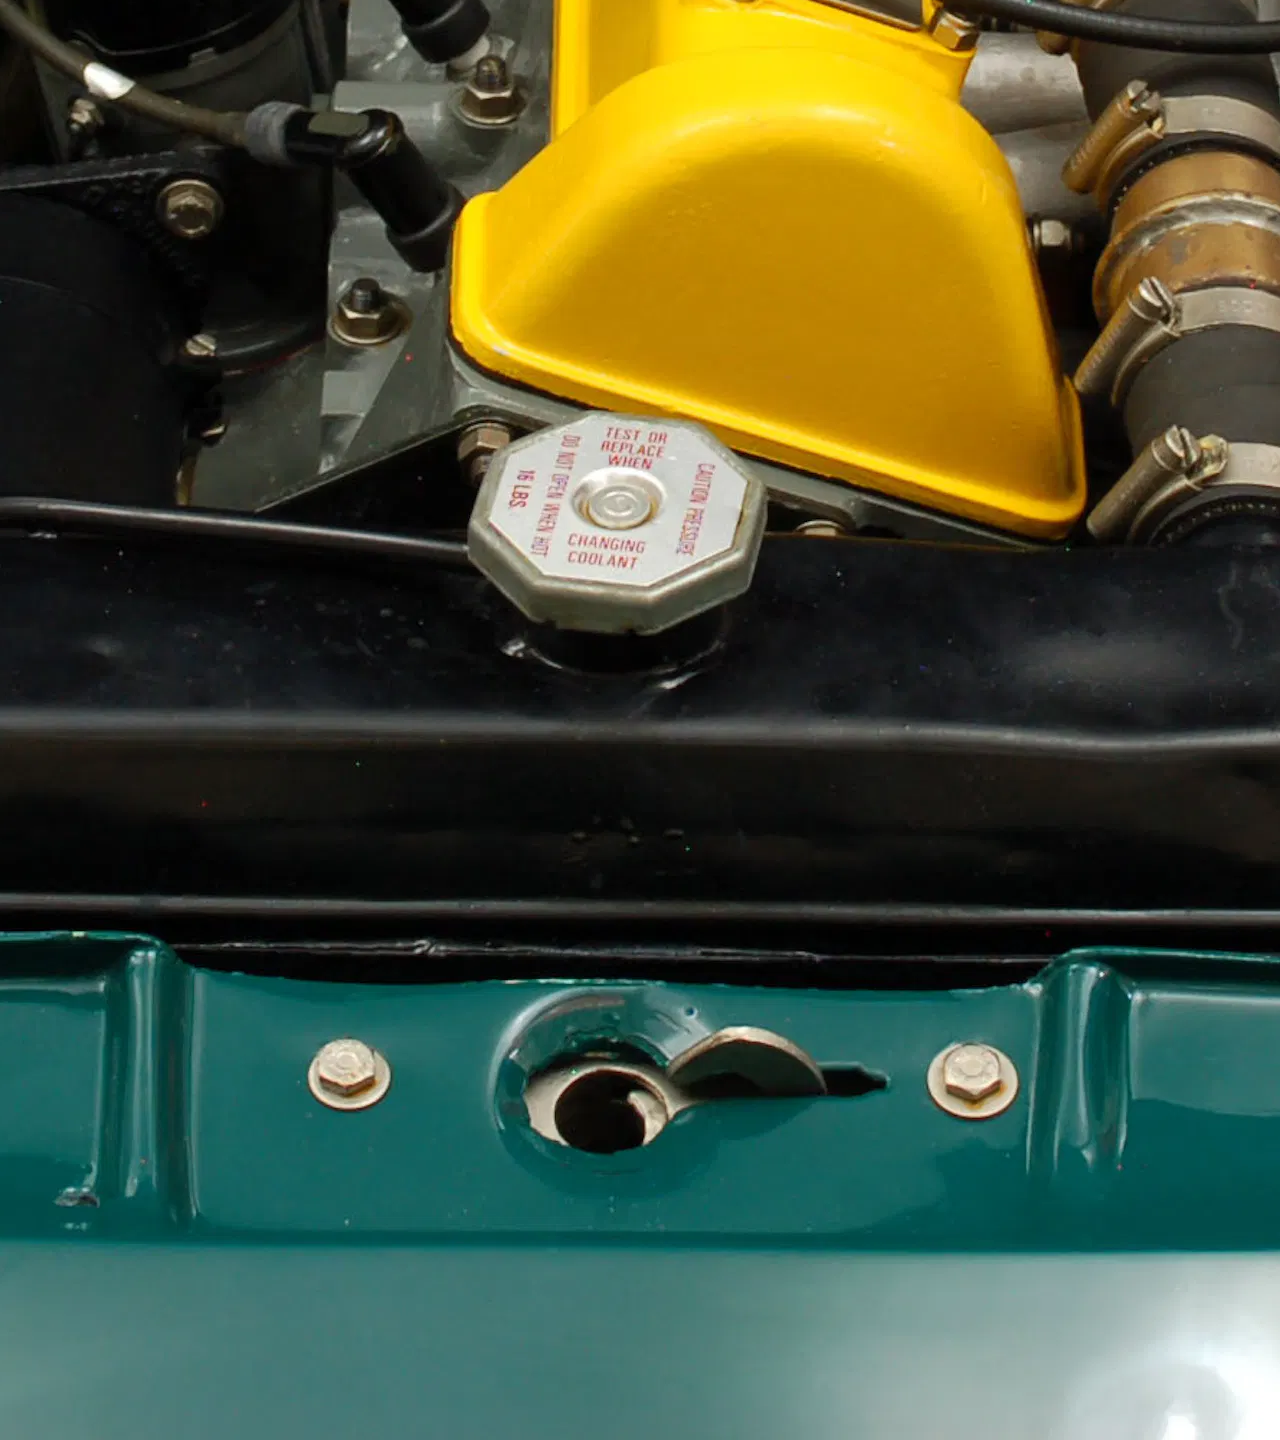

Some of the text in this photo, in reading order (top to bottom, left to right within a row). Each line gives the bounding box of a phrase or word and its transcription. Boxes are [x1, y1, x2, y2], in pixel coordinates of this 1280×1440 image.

[561, 434, 581, 449] DO
[606, 426, 669, 445] TEST OR
[600, 440, 666, 458] REPLACE
[556, 451, 577, 471] NOT
[608, 454, 654, 471] WHEN
[690, 462, 716, 503] CAUTION
[509, 485, 534, 509] LBS
[567, 532, 647, 553] CHANGING
[567, 550, 639, 571] COOLANT
